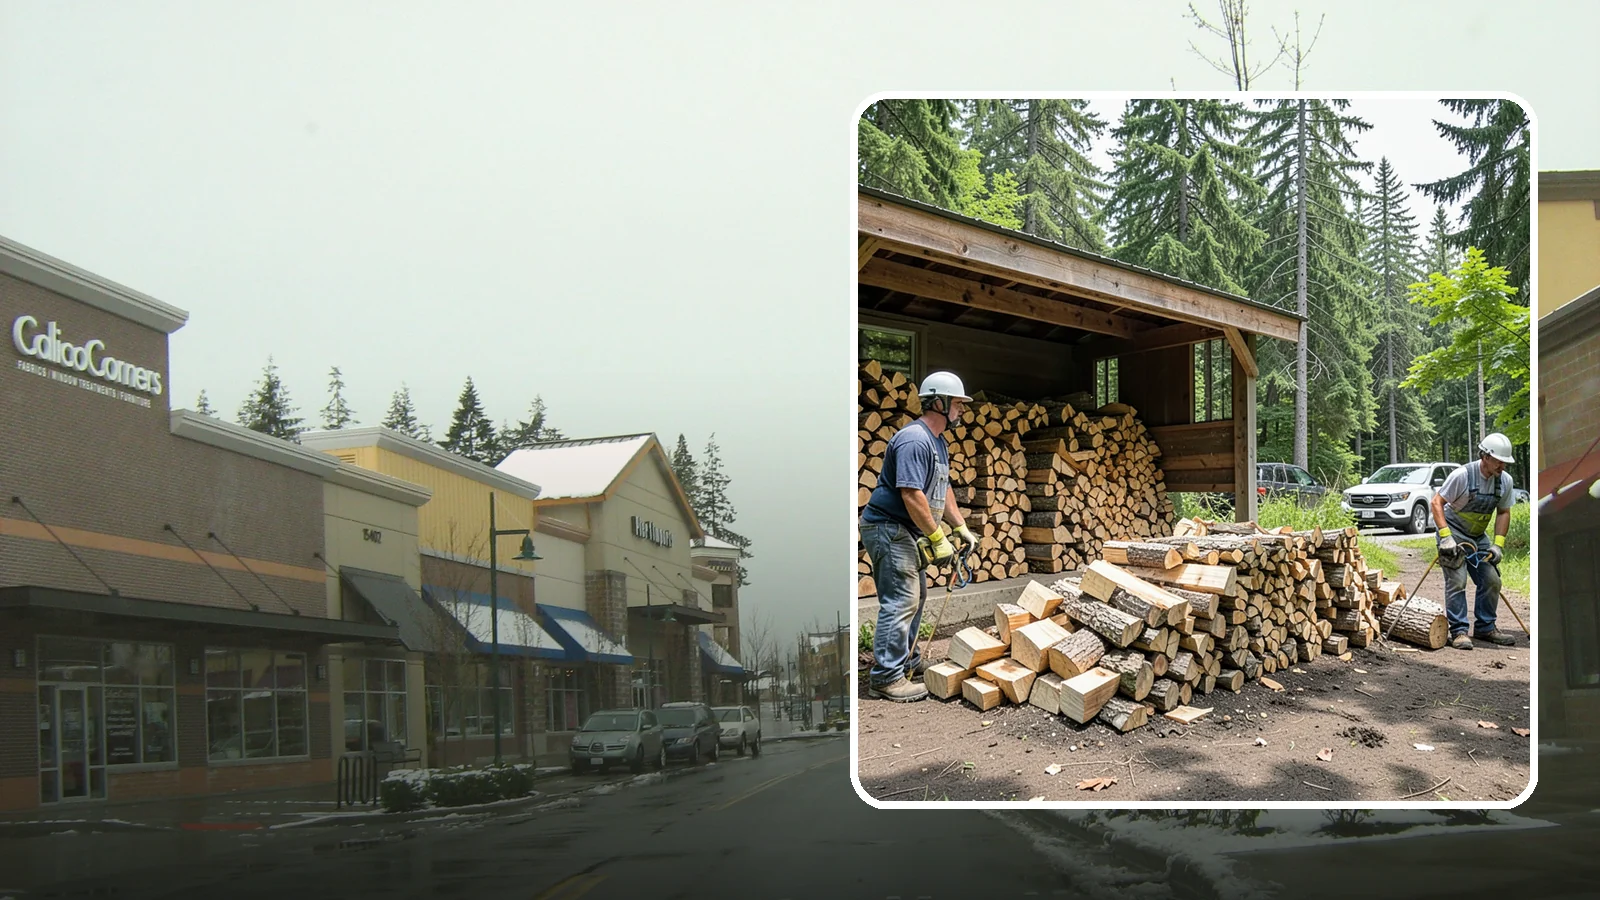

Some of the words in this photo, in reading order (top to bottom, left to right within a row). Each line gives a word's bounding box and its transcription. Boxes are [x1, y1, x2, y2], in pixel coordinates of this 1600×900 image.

[17, 359, 46, 377] FABRICS
[51, 370, 78, 386] WINDOW
[79, 377, 116, 398] TREATMENTS
